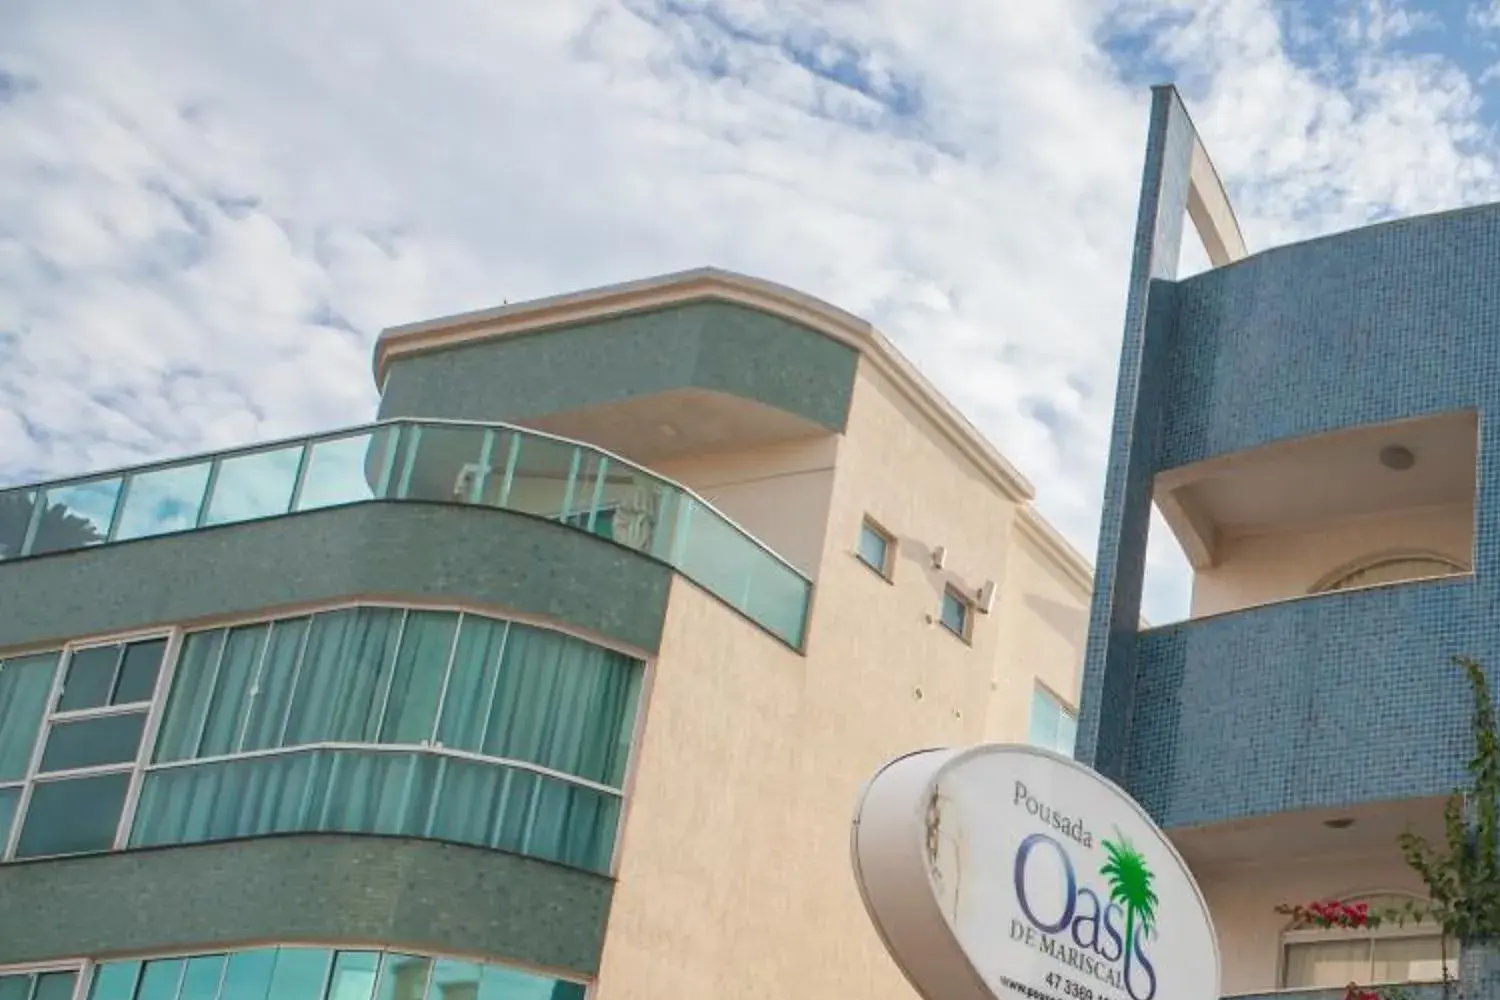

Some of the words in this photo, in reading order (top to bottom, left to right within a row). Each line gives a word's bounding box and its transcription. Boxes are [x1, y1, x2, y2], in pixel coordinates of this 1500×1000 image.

[1013, 780, 1093, 848] Pousada
[1009, 919, 1036, 948] DE
[1039, 933, 1126, 991] MARISCAL
[1045, 972, 1063, 990] 47
